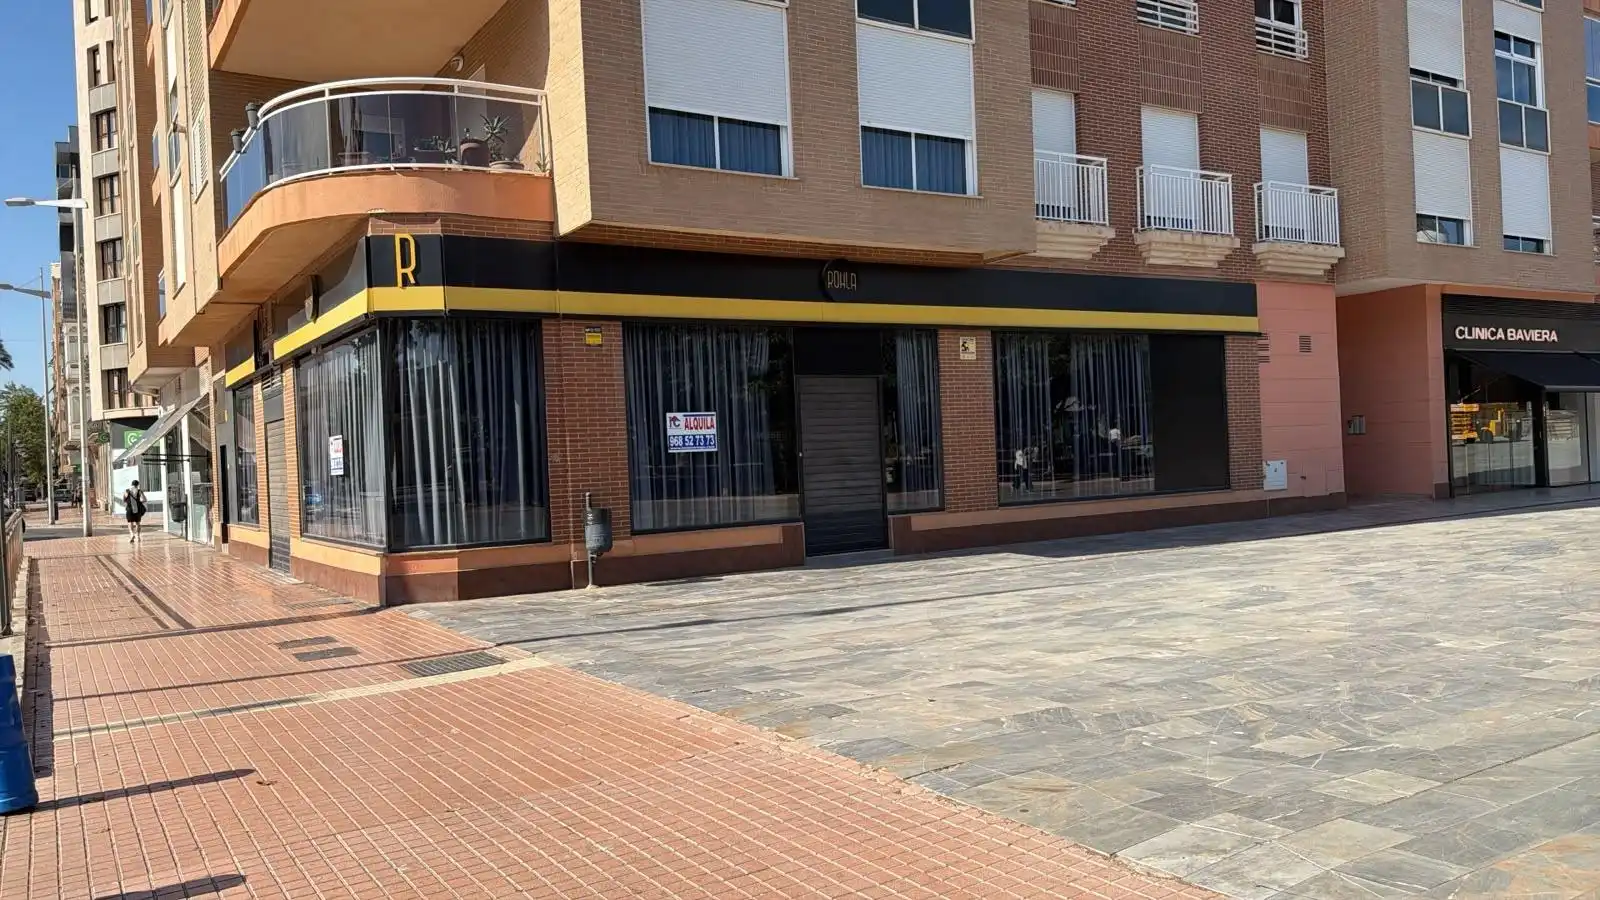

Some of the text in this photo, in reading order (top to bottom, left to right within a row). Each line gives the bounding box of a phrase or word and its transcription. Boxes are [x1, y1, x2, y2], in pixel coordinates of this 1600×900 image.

[395, 233, 416, 289] R
[827, 270, 857, 291] ROHLA
[1455, 326, 1558, 342] CLINICA BAVIERA
[684, 417, 715, 430] ALQUILA
[669, 434, 715, 447] 968 52 73 73
